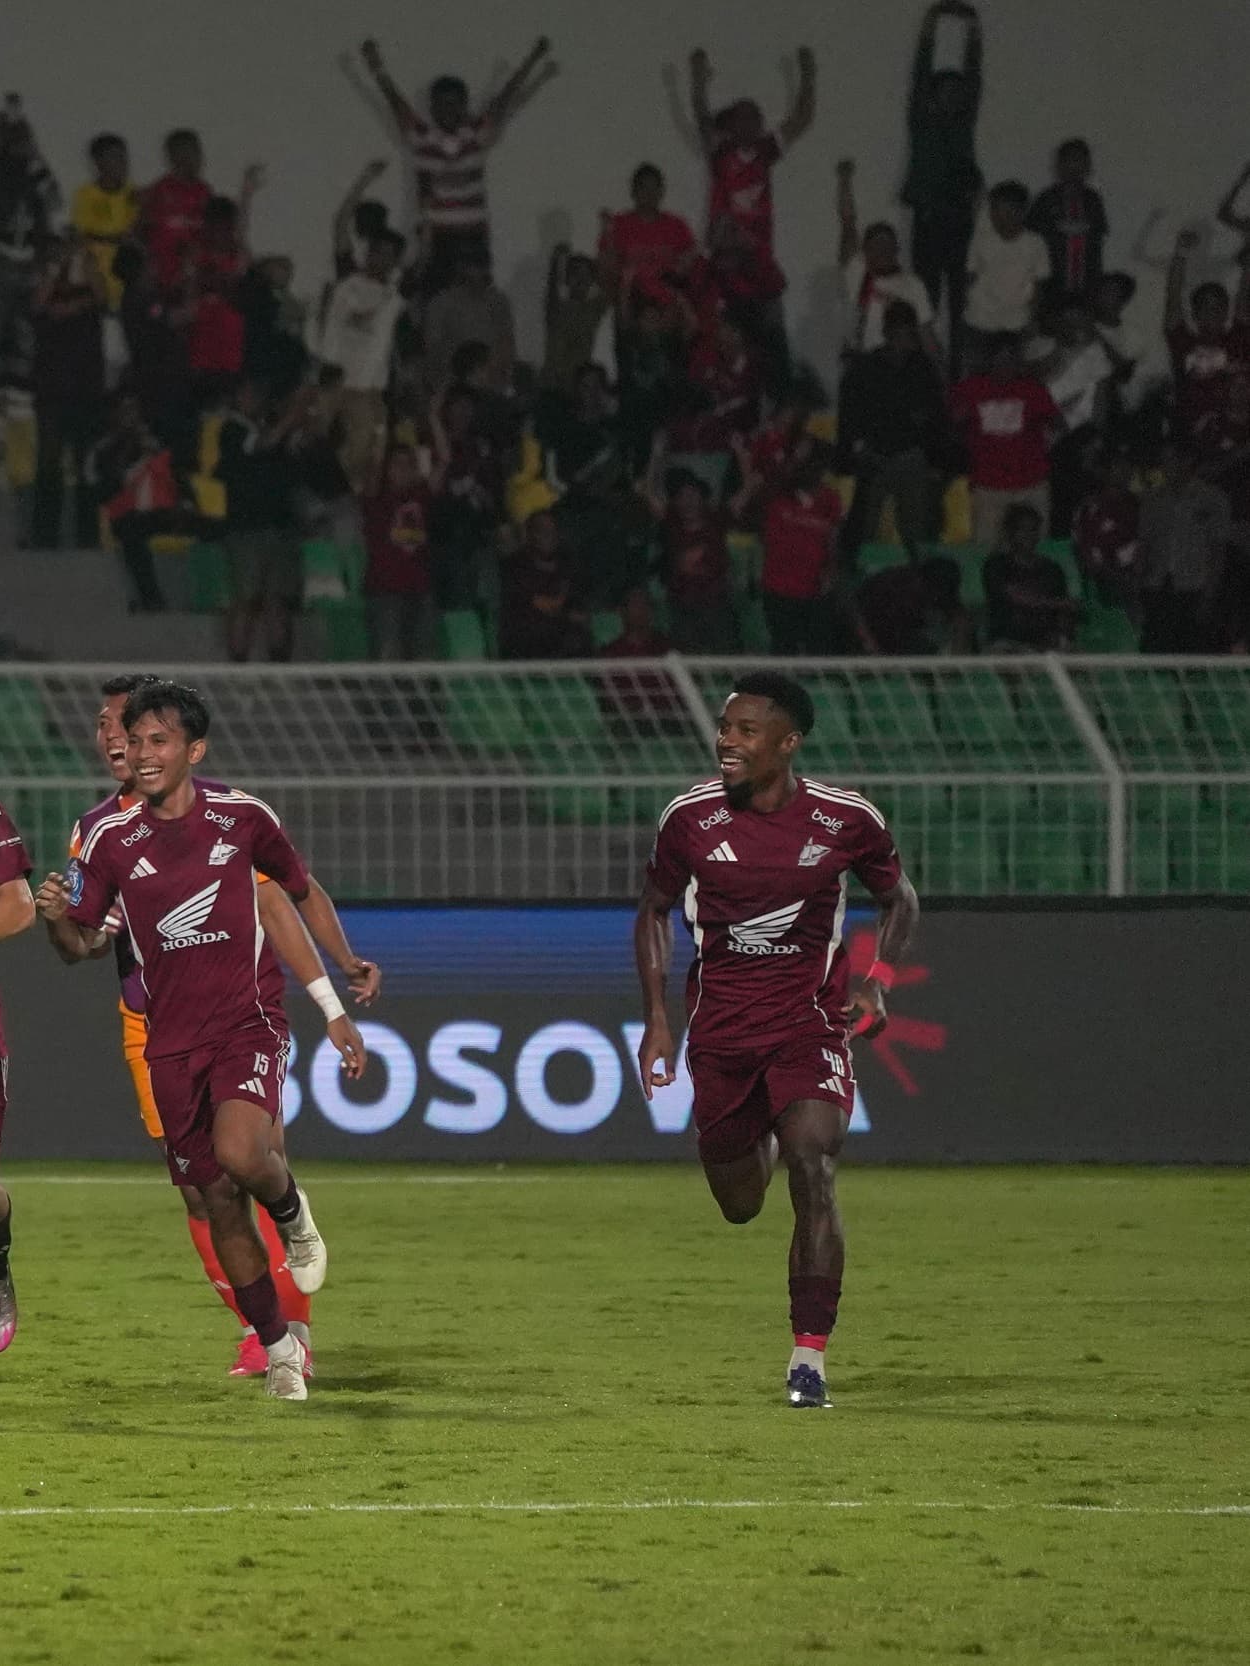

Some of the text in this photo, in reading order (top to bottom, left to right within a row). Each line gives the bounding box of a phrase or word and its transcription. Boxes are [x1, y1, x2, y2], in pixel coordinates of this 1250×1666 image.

[160, 931, 231, 951] HONDA
[726, 941, 803, 956] HONDA
[253, 1051, 270, 1076] 15
[821, 1047, 846, 1077] 40
[281, 1020, 872, 1133] OSO
